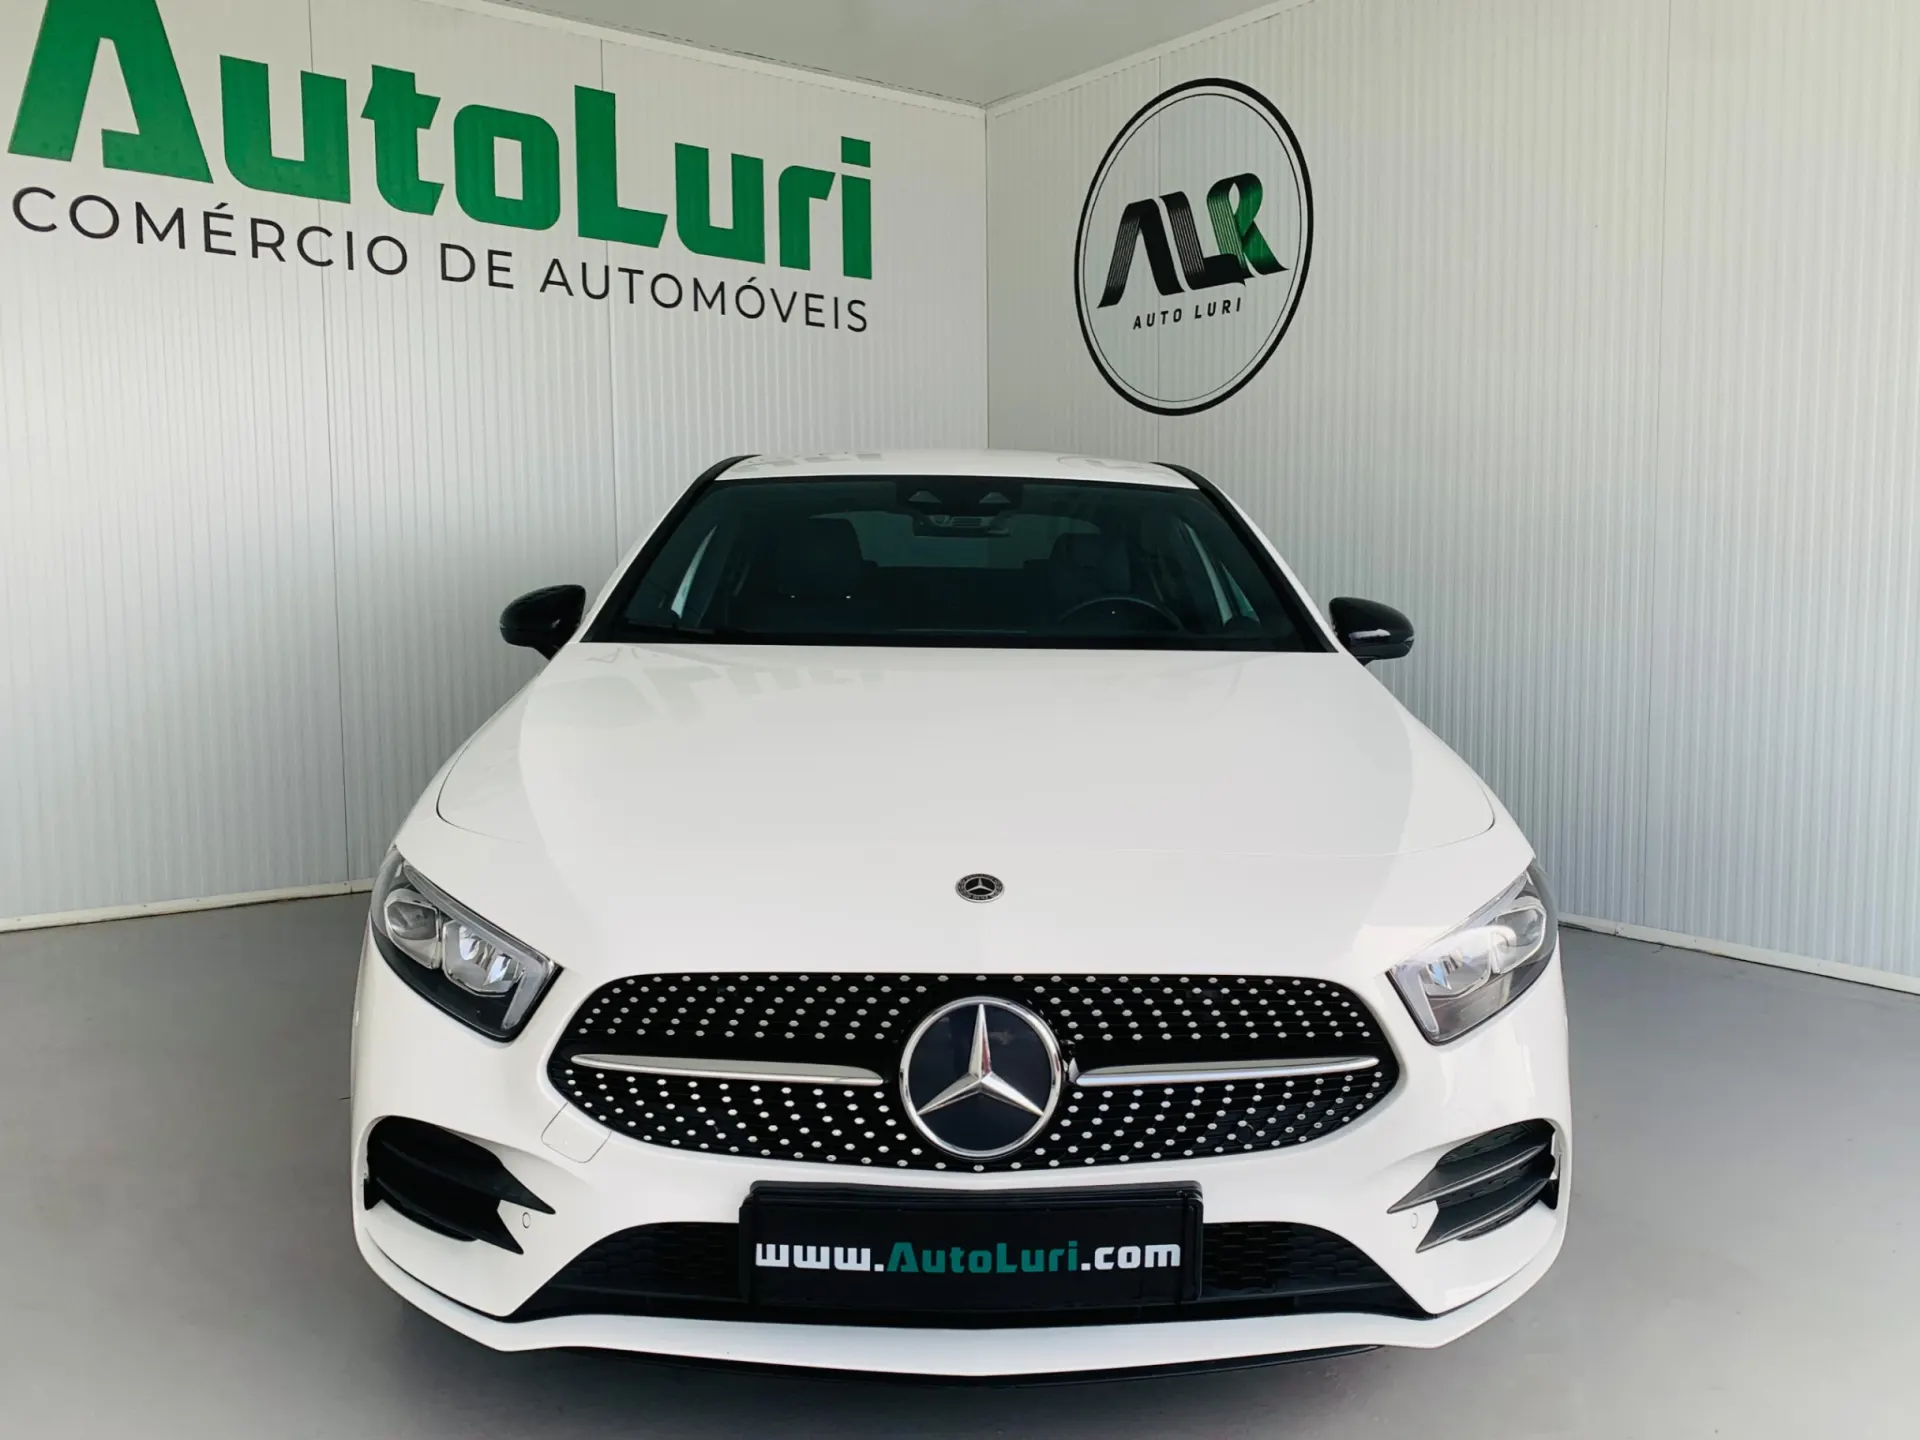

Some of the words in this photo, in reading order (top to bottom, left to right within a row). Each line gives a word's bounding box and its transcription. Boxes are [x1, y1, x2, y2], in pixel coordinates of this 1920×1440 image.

[7, 0, 873, 280] AutoLuri
[12, 186, 409, 276] COMÉRCIO
[440, 243, 515, 290] DE
[539, 257, 868, 333] AUTOMÓVEIS
[1132, 307, 1183, 331] AUTO
[1194, 297, 1242, 320] LURI
[755, 1240, 1181, 1274] www.AutoLuri.com
